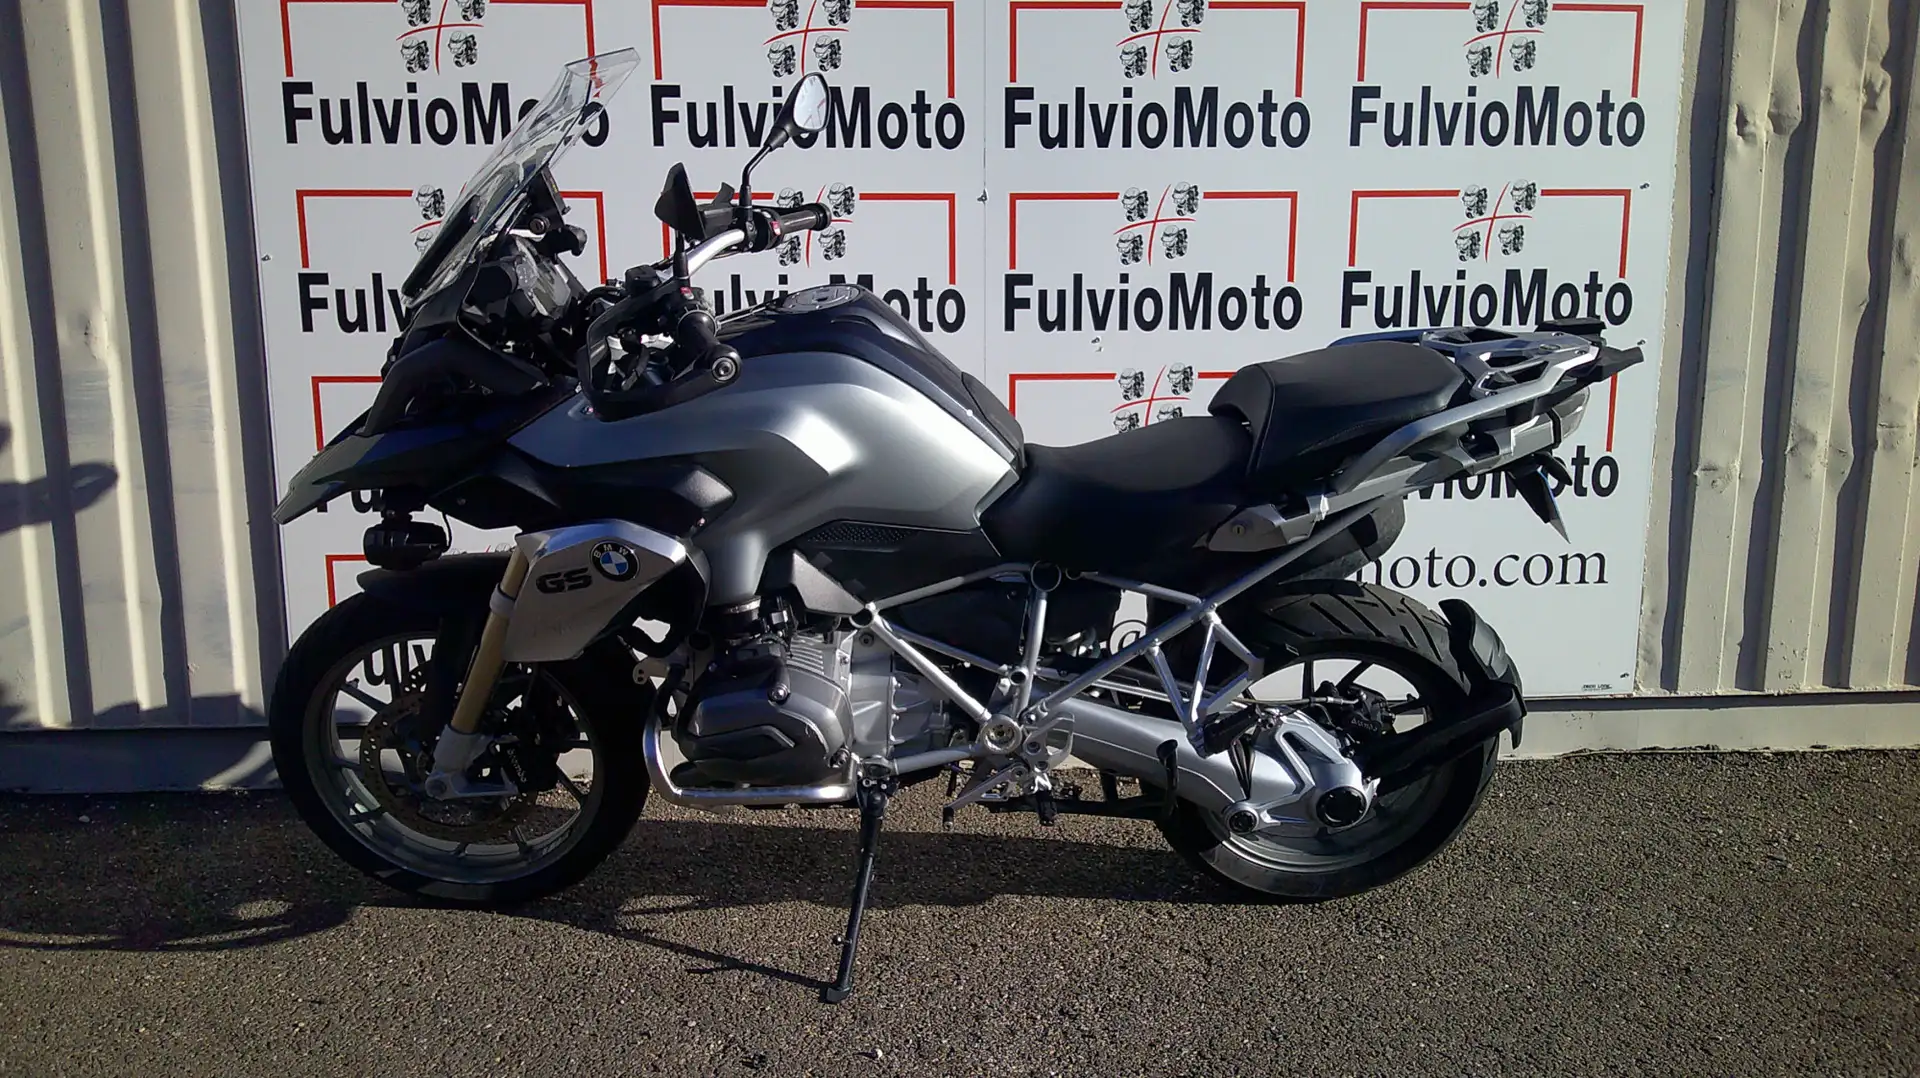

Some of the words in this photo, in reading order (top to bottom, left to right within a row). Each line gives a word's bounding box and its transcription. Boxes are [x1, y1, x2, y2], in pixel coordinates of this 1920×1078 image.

[281, 81, 610, 148] FulvioMo
[1003, 86, 1312, 150] FulvioMoto
[1349, 85, 1646, 148] FulvioMoto
[1003, 273, 1303, 333] FulvioMoto
[1340, 268, 1633, 329] FulvioMoto
[535, 567, 593, 594] GS
[593, 543, 629, 559] BMW
